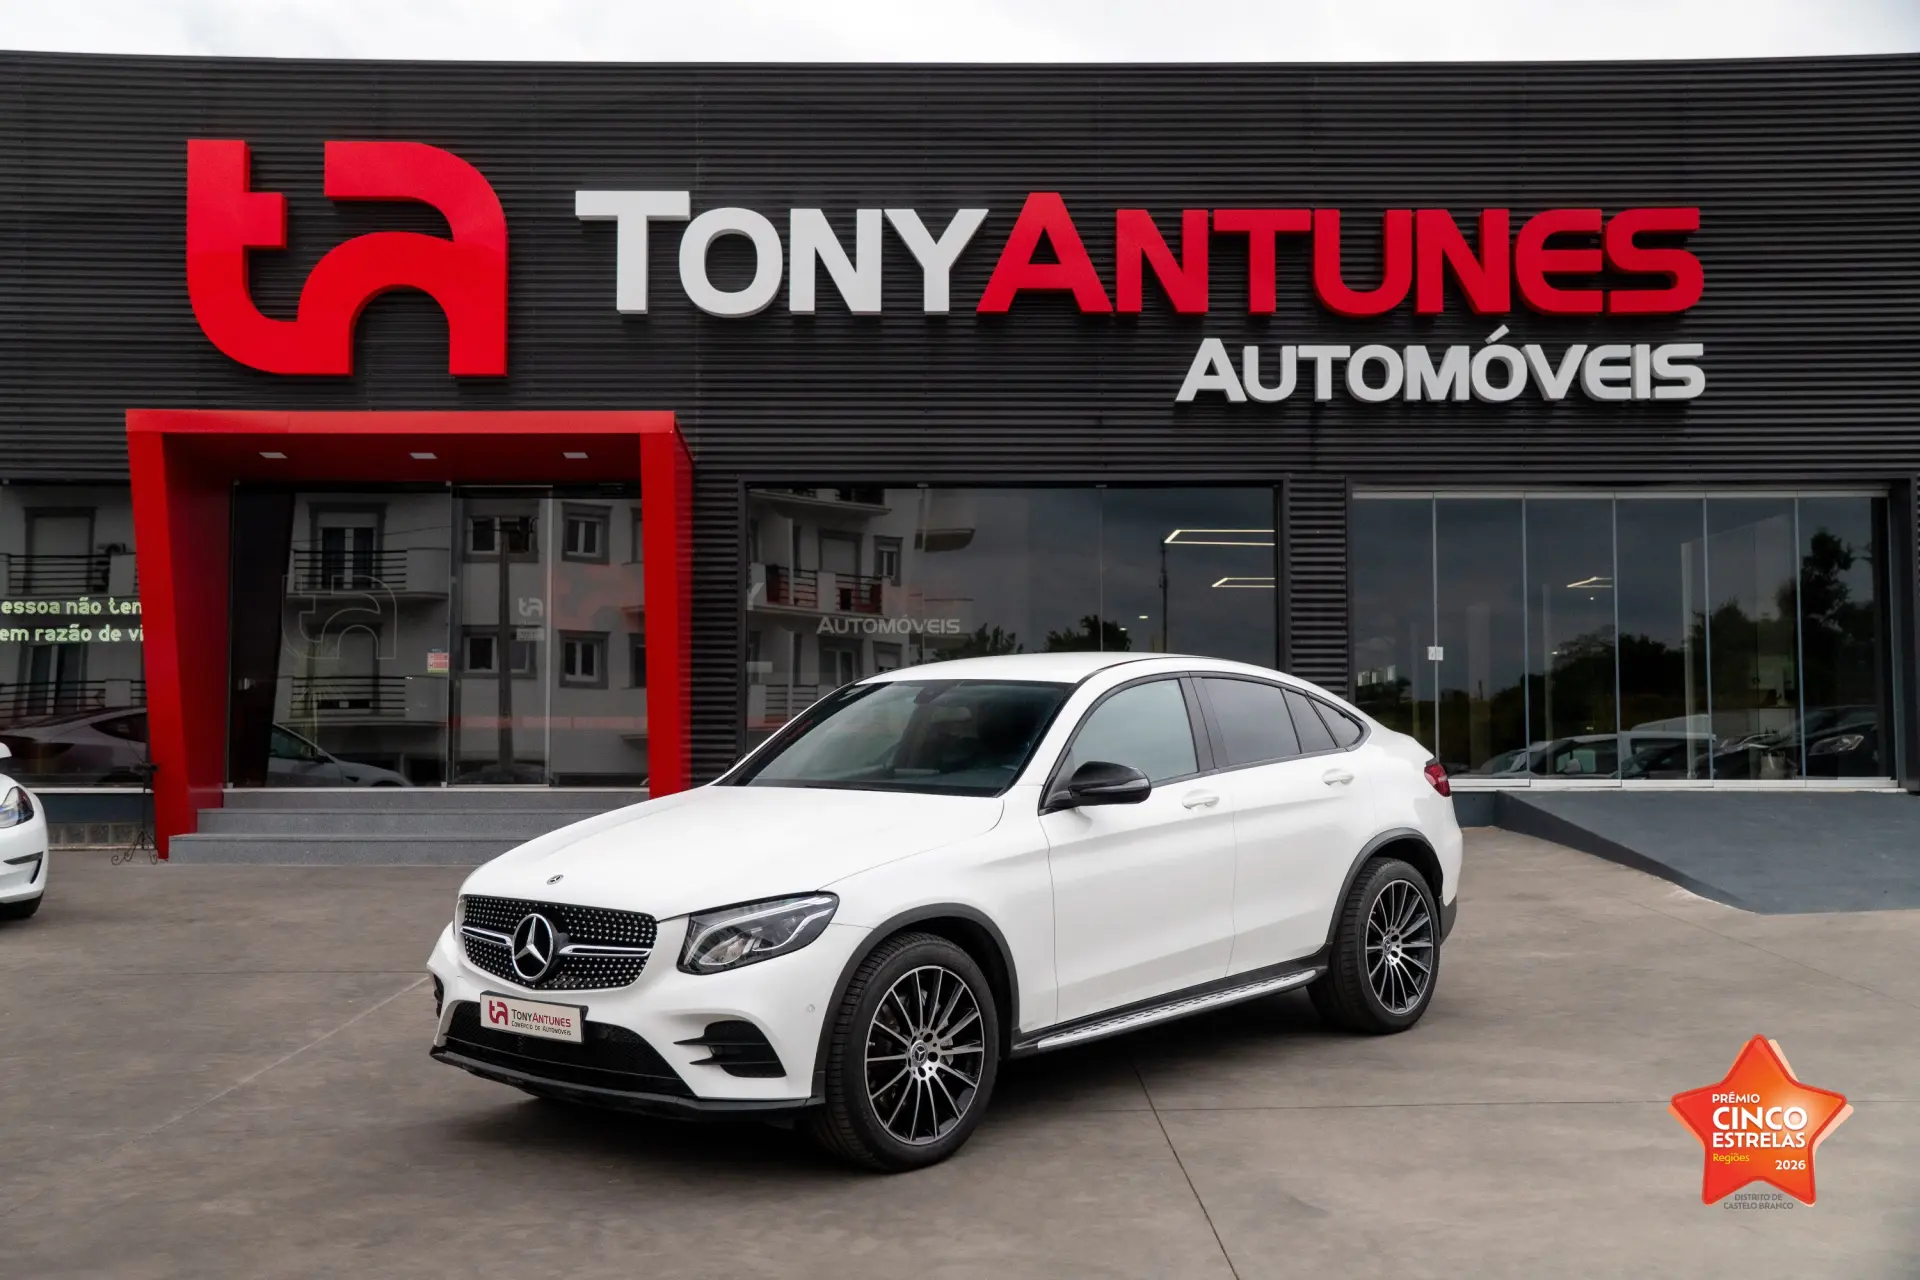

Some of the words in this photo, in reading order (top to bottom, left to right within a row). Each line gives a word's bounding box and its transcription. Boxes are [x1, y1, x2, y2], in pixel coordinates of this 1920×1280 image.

[1175, 324, 1706, 403] AUTOMÓVEIS
[66, 597, 102, 614] não
[35, 624, 92, 642] razão
[99, 624, 122, 642] de
[816, 614, 961, 634] AUTOMÓVEIS
